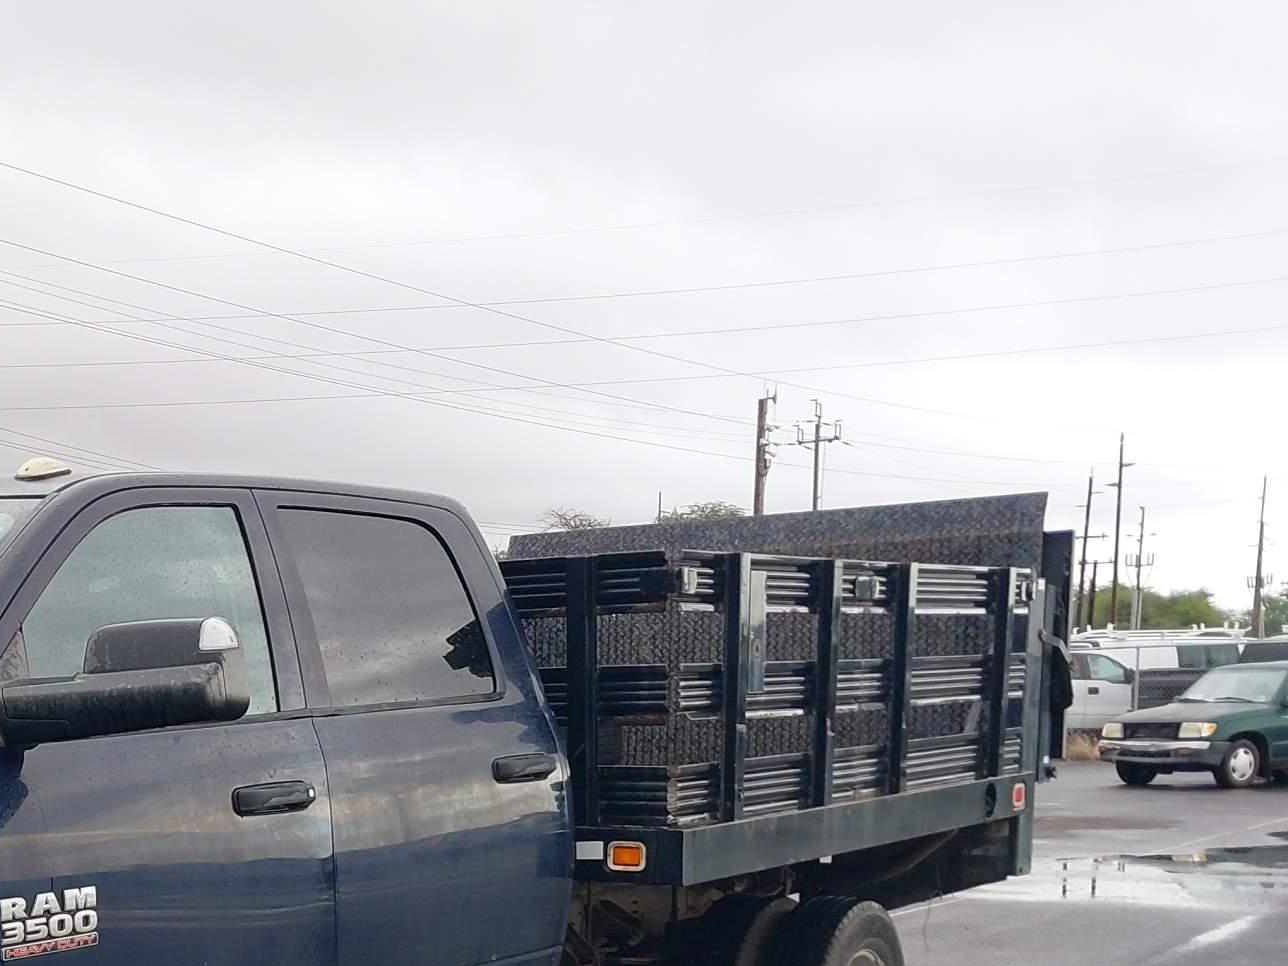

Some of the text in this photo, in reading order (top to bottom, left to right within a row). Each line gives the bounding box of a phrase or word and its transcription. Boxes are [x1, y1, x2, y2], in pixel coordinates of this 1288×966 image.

[0, 885, 97, 922] RAM
[0, 909, 98, 947] 3500
[5, 934, 96, 959] HEAVY DUTY
